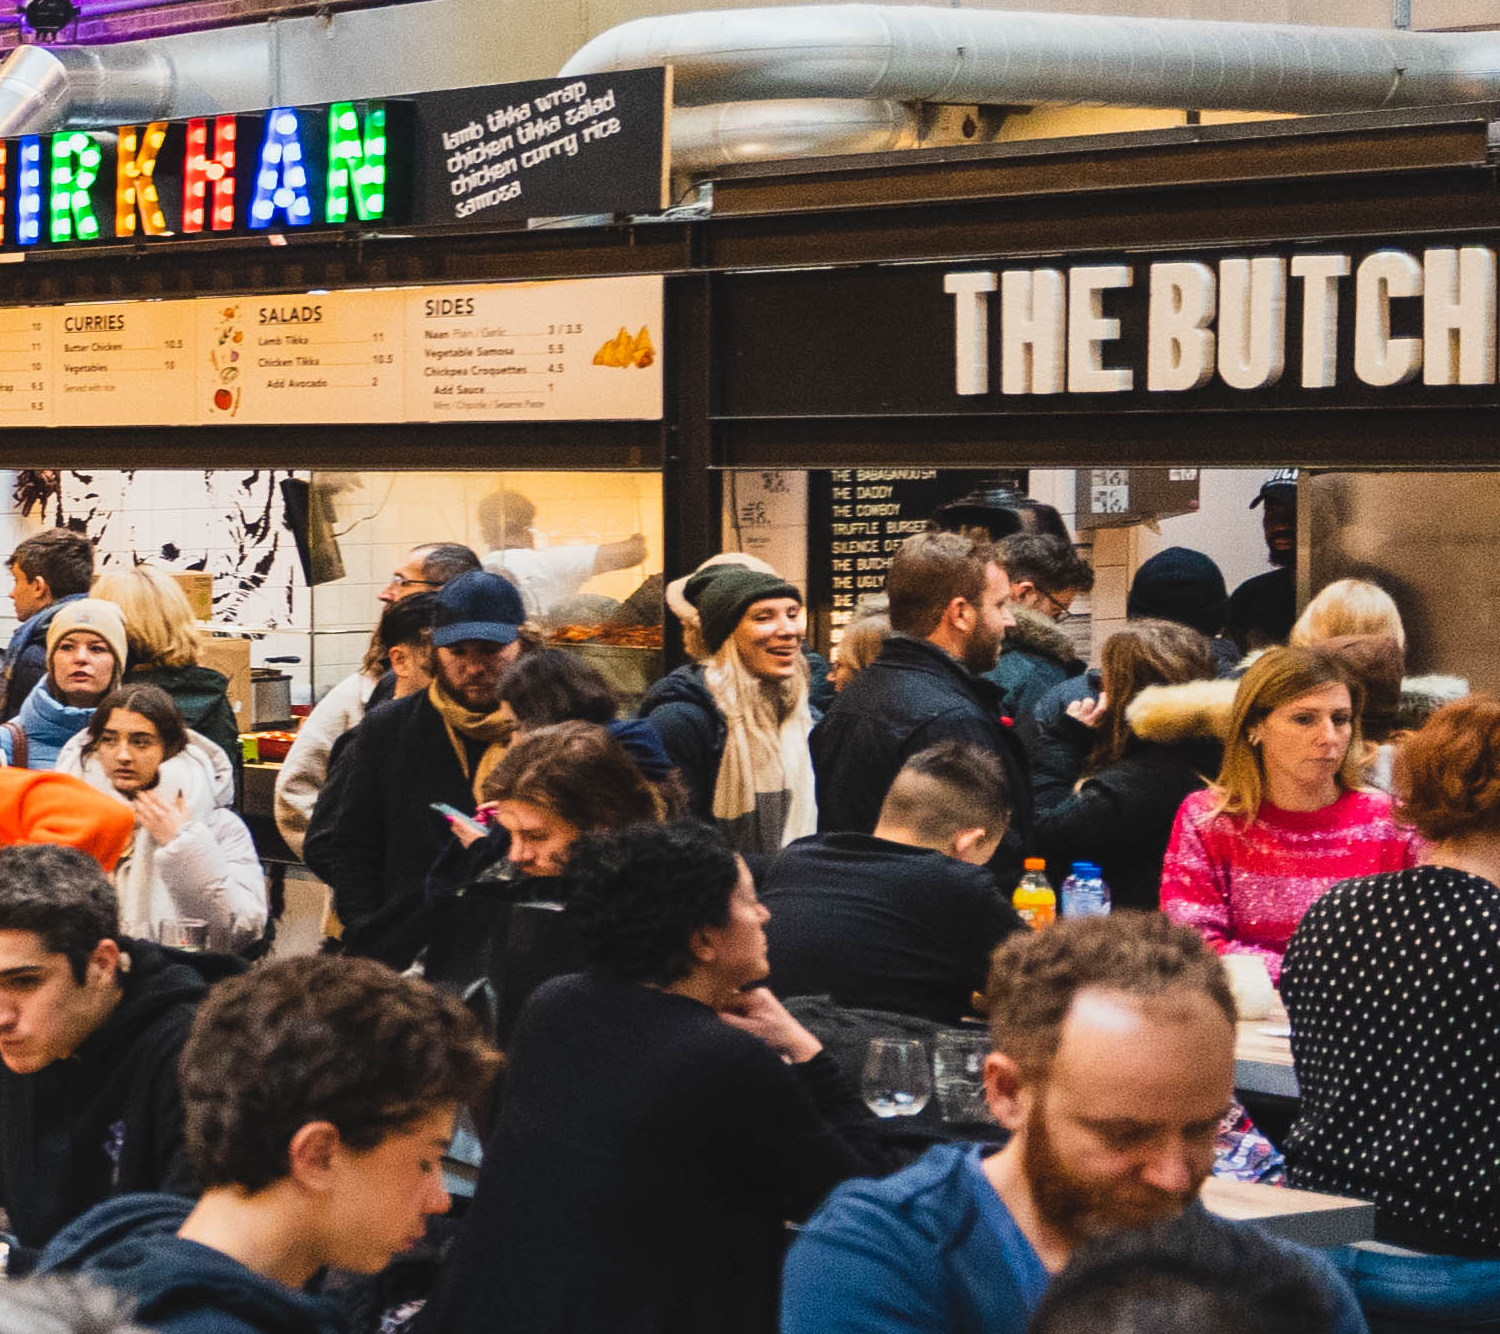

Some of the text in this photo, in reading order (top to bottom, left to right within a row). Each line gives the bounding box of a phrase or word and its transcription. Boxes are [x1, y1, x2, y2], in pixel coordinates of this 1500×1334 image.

[442, 81, 587, 150] lamb tikka wrap
[447, 89, 616, 173] chicken tikka salad
[451, 117, 621, 196] chicken curry rice
[455, 180, 523, 219] samosa
[425, 297, 475, 317] SIDES
[259, 305, 322, 323] SALADS
[64, 314, 125, 332] CURRIES
[944, 247, 1498, 396] THE BUTCH
[259, 335, 283, 346] Lamb
[286, 335, 309, 345] Tikka
[424, 329, 450, 339] Naan
[64, 343, 89, 353] Butter
[91, 342, 122, 352] Chicken
[424, 347, 474, 359] Vegetable
[477, 346, 514, 357] Samosa
[259, 357, 293, 367] Chicken
[296, 356, 320, 366] Tikka
[64, 363, 108, 374] Vegetables
[424, 366, 469, 378] Chickpea
[471, 366, 527, 377] Croquettes
[267, 378, 286, 388] Add
[288, 378, 328, 388] Avocado
[434, 384, 454, 395] Add
[456, 384, 485, 395] Sauce
[832, 470, 852, 482] THE
[832, 485, 894, 500] THE DADDY
[832, 503, 901, 517] THE COWBOY
[832, 522, 880, 535] TRUFFLE
[832, 540, 880, 554] SILENCE
[832, 559, 853, 571] THE
[832, 576, 853, 589] THE
